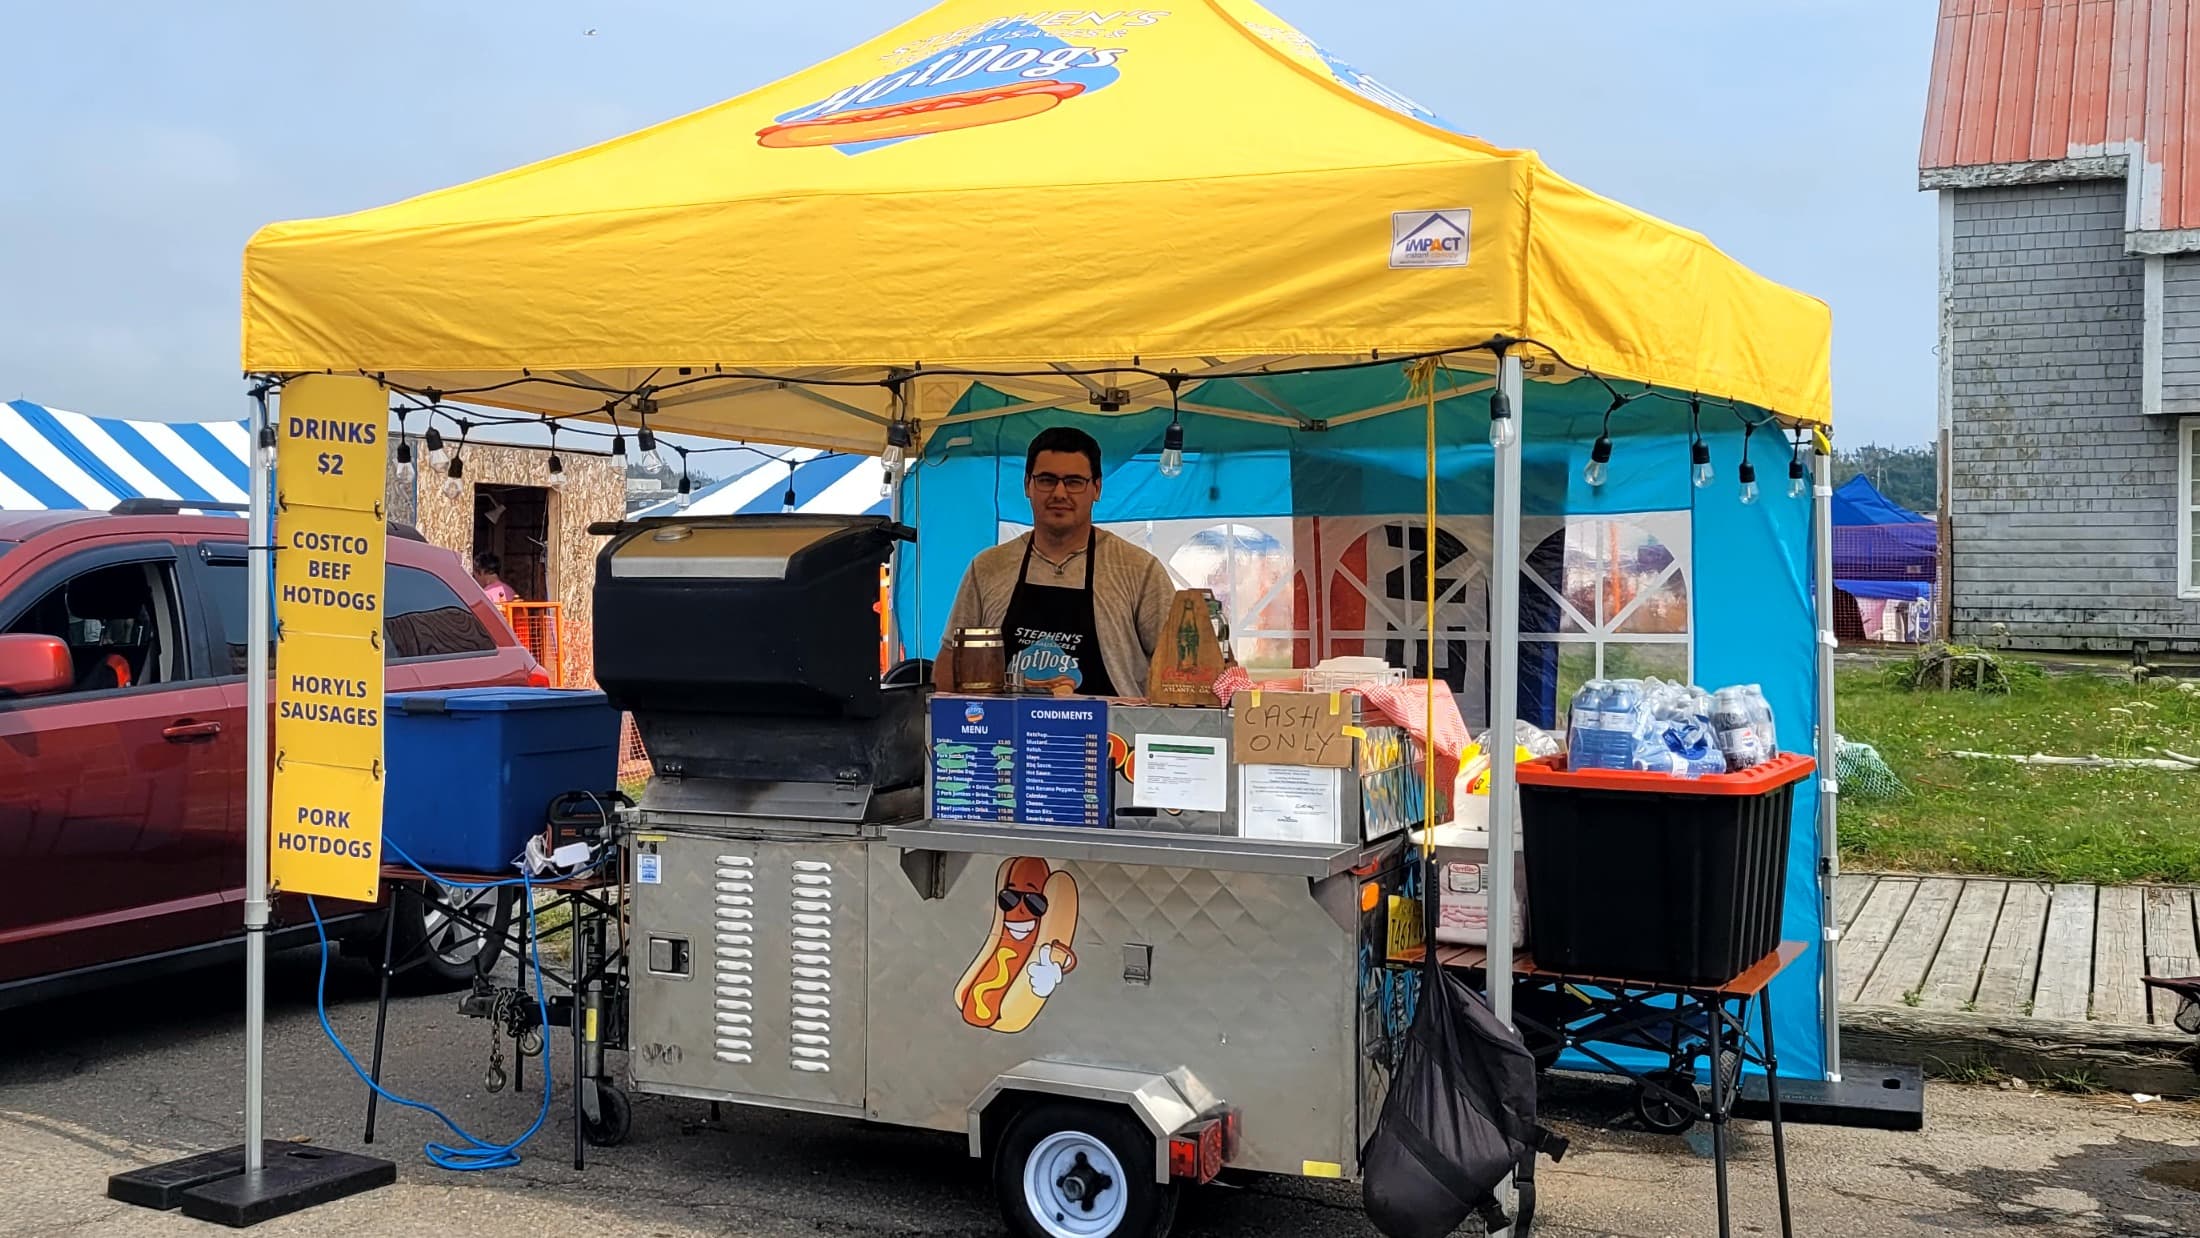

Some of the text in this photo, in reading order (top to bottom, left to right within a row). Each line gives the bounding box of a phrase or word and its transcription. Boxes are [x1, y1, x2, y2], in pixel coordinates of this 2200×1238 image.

[783, 44, 1128, 122] HotDogs
[288, 416, 377, 445] DRINKS
[317, 452, 344, 475] $2
[292, 531, 369, 555] COSTCO
[308, 559, 352, 580] BEEF
[282, 584, 377, 611] HOTDOGS
[1014, 627, 1083, 644] STEPHEN'S
[1011, 649, 1080, 673] HotDogs
[291, 674, 368, 698] HORYLS
[280, 701, 378, 727] SAUSAGES
[1030, 710, 1093, 721] CONDIMENTS
[1244, 704, 1320, 729] CASH
[961, 725, 989, 735] MENU
[1249, 731, 1336, 763] ONLY
[297, 807, 352, 828] PORK
[278, 832, 373, 859] HOTDOGS
